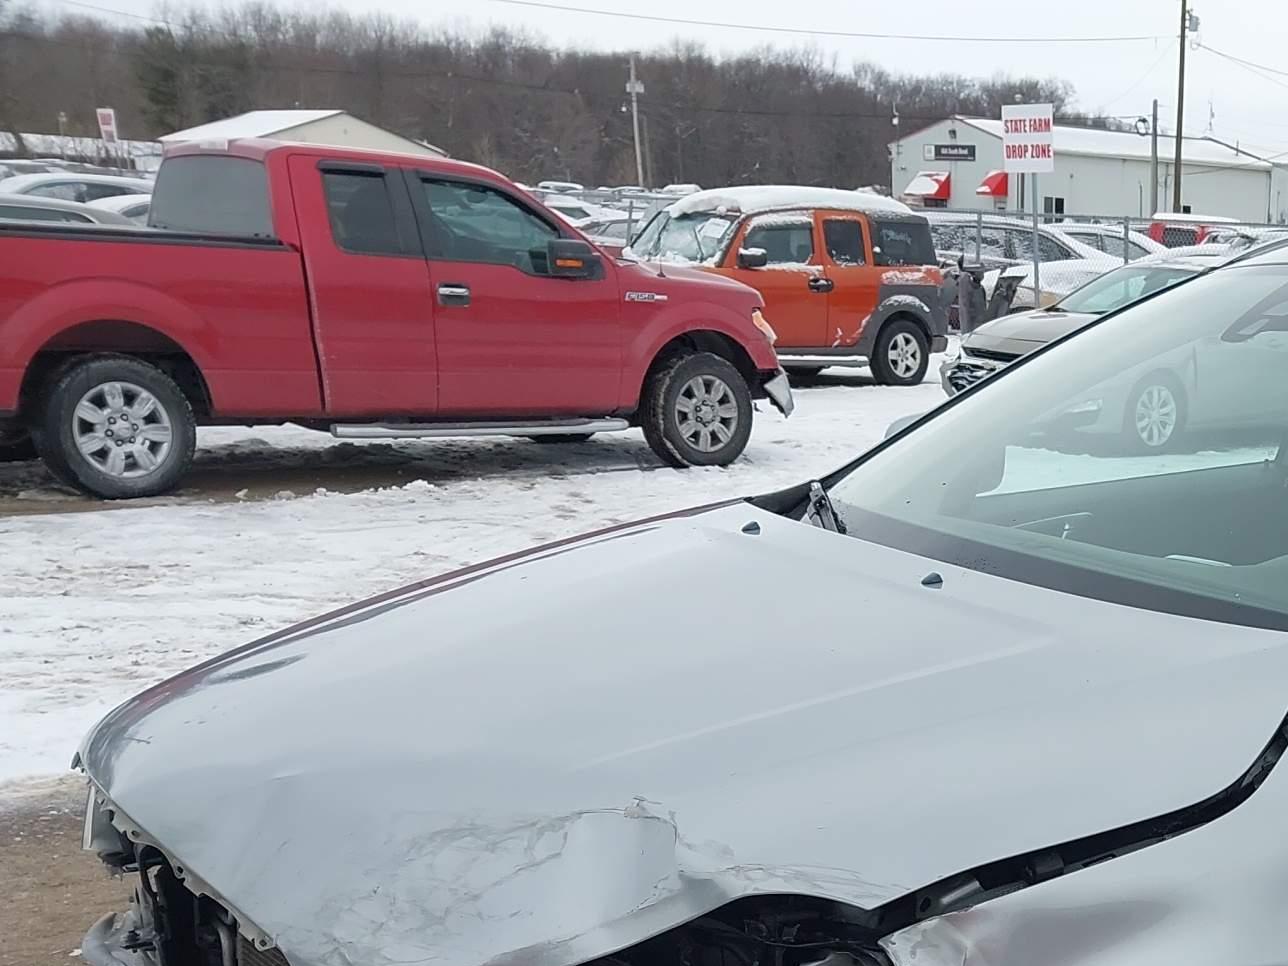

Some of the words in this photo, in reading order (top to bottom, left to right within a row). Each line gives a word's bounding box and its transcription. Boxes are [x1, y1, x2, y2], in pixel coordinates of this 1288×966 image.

[1004, 119, 1027, 134] STATE
[1029, 117, 1051, 132] FARM
[1006, 144, 1028, 159] DROP
[1031, 143, 1052, 158] ZONE
